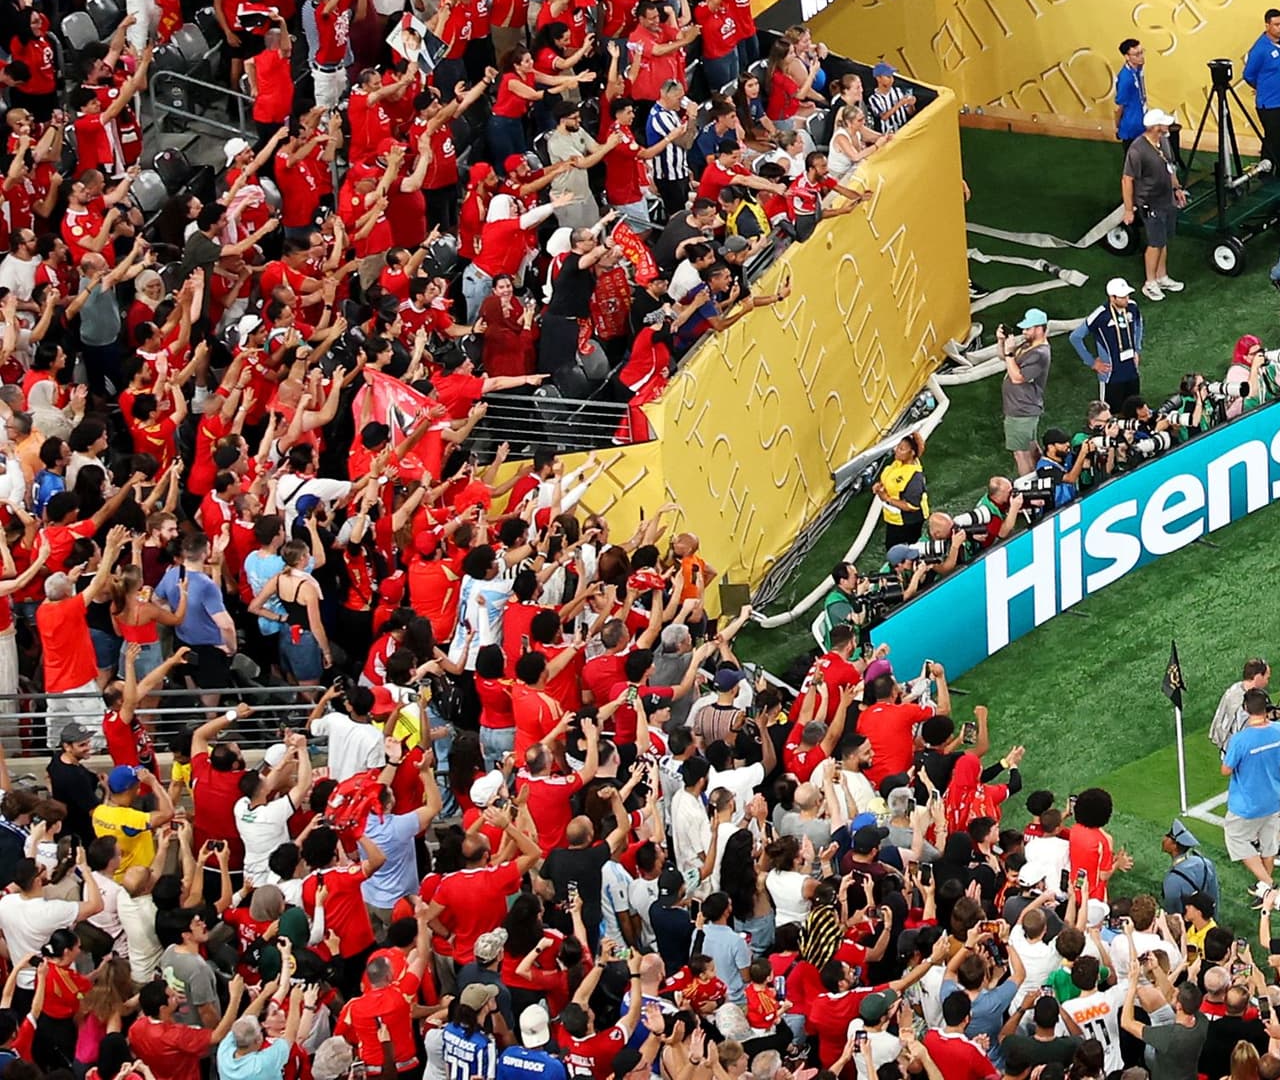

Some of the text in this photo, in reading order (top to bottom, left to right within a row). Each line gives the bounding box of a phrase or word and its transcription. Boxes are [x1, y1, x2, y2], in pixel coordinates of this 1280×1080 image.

[1073, 1002, 1111, 1022] BMG
[1084, 1017, 1112, 1046] 11
[502, 1055, 546, 1073] SUPER BOCK
